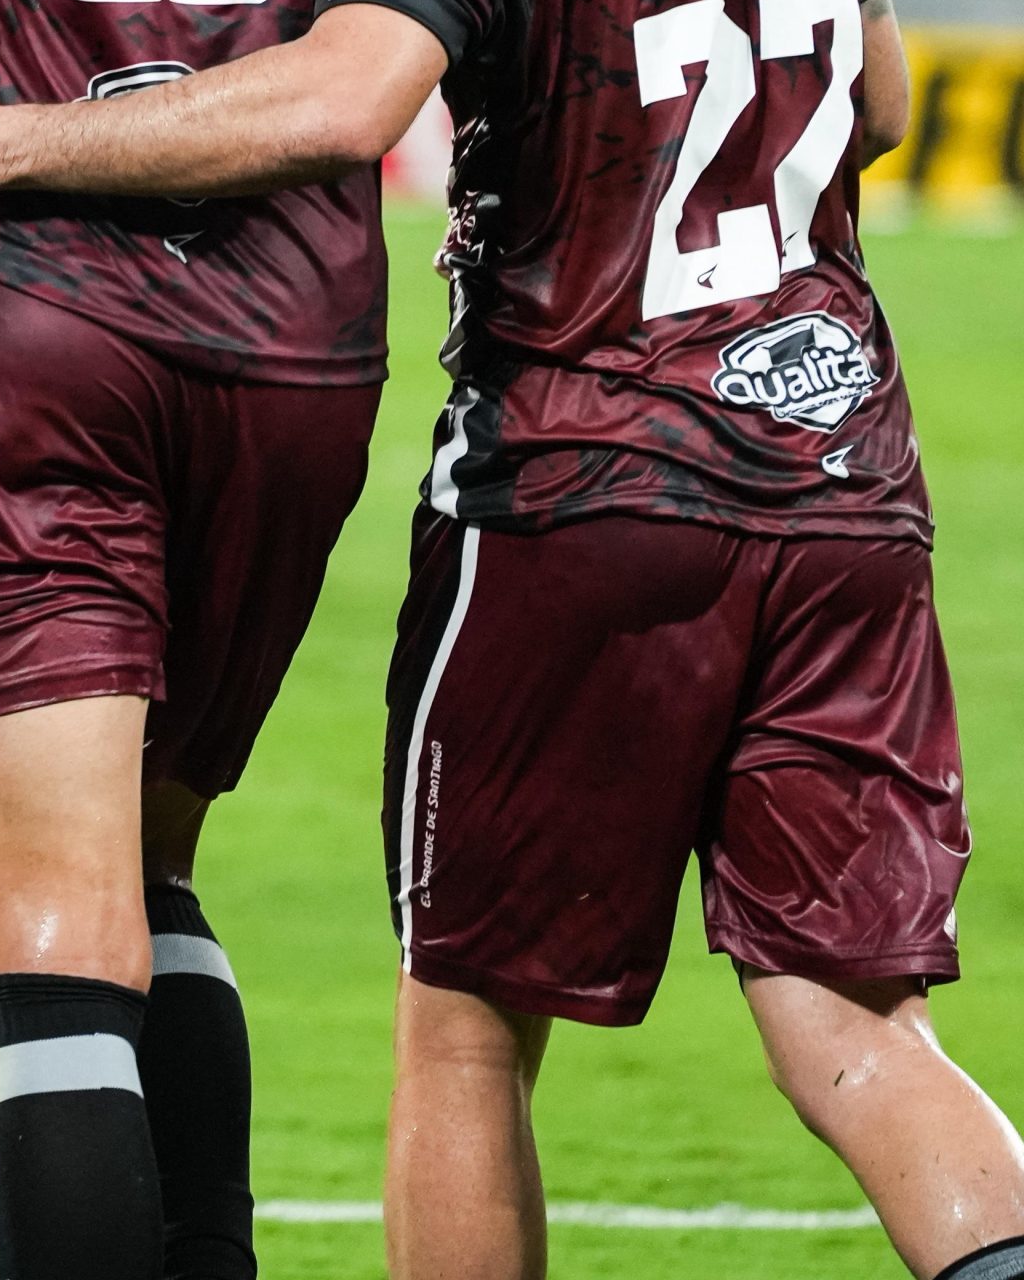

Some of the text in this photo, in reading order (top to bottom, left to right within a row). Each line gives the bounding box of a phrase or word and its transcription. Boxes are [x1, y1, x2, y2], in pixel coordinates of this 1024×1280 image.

[420, 740, 443, 908] EL GRANDE DE SANTIAGO
